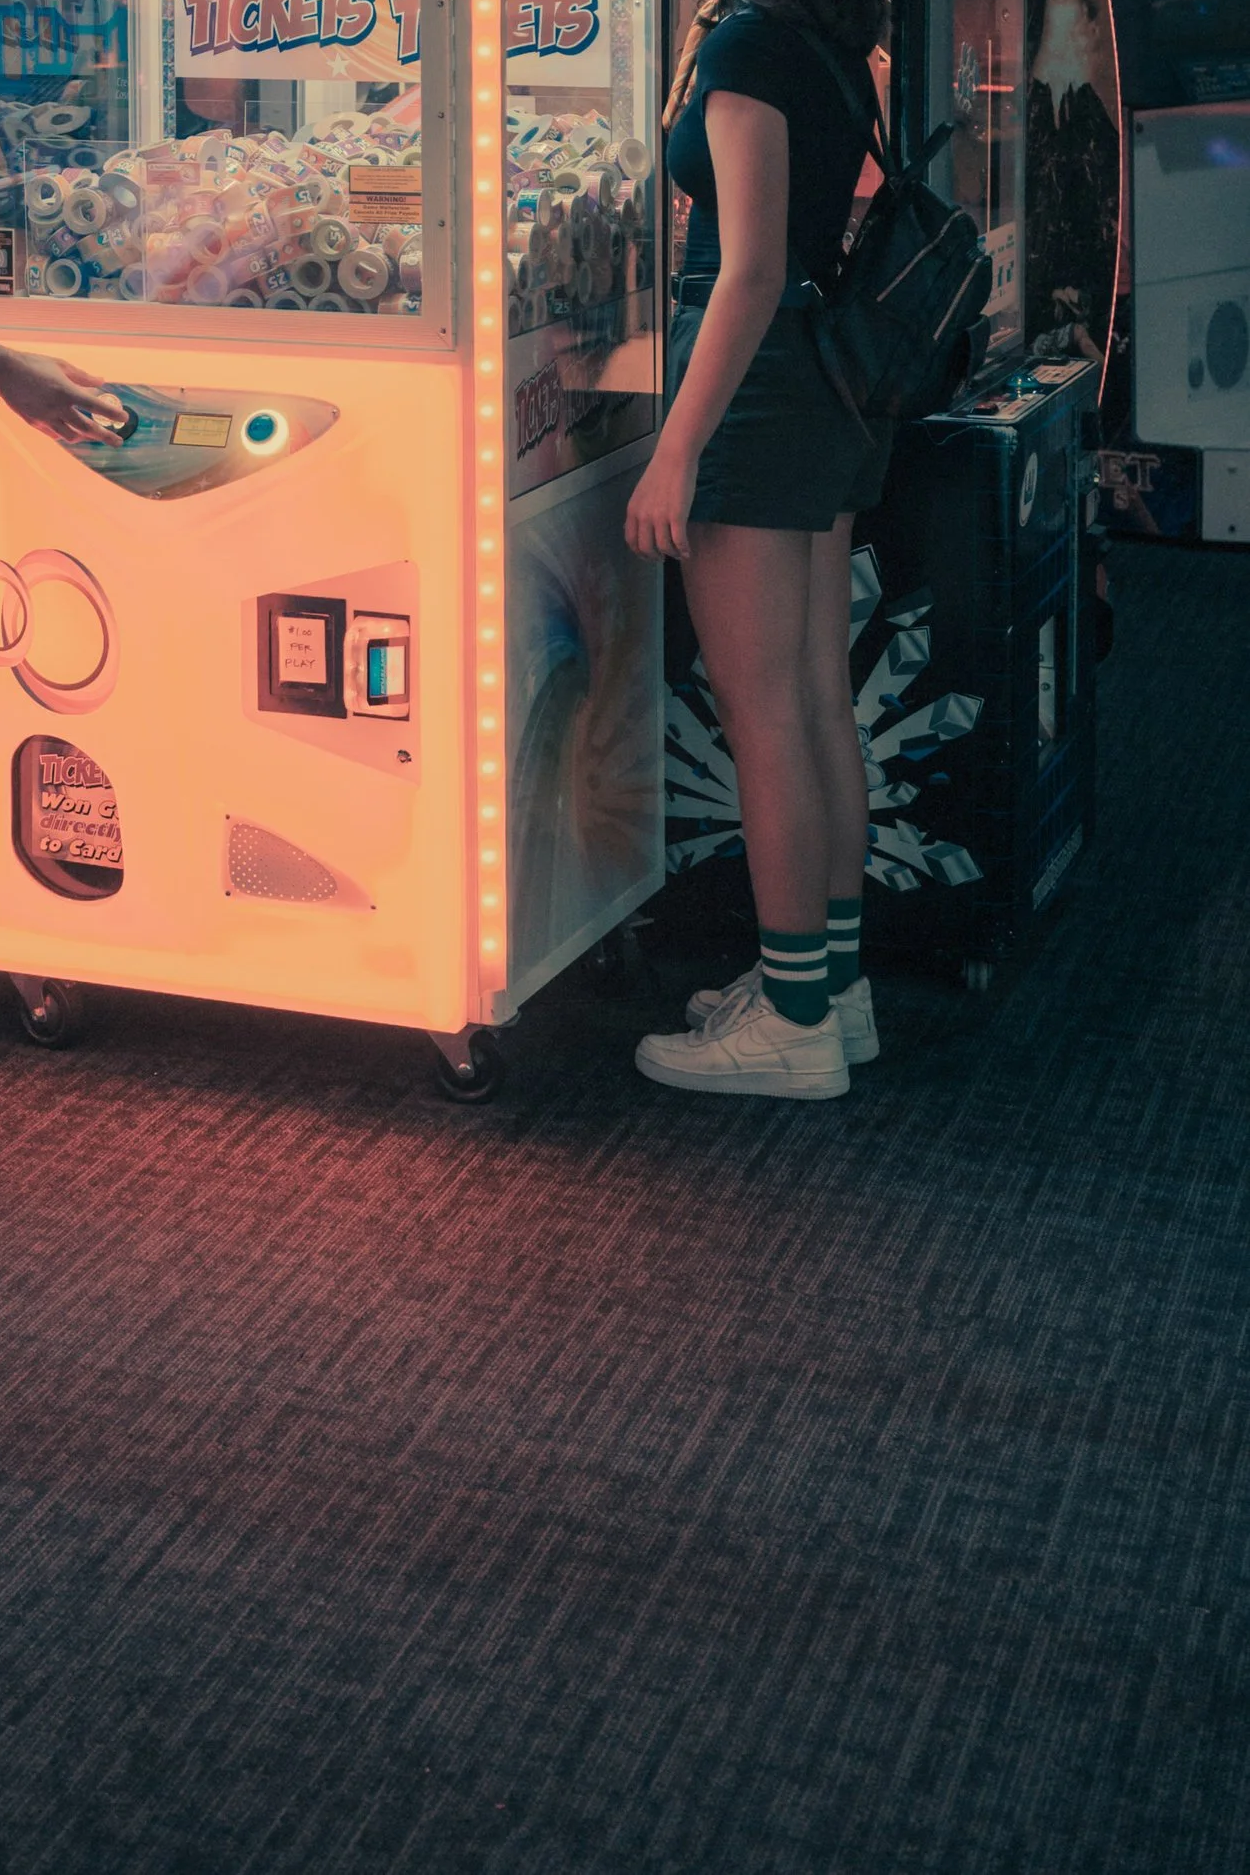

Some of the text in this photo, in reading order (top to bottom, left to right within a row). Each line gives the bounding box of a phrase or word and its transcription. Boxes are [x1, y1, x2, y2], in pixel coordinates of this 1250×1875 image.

[366, 195, 407, 203] WARNING!
[289, 642, 313, 653] PER
[284, 658, 317, 669] PLAY
[39, 753, 114, 789] TICKE
[41, 791, 92, 816] Won
[40, 836, 123, 863] to Card
